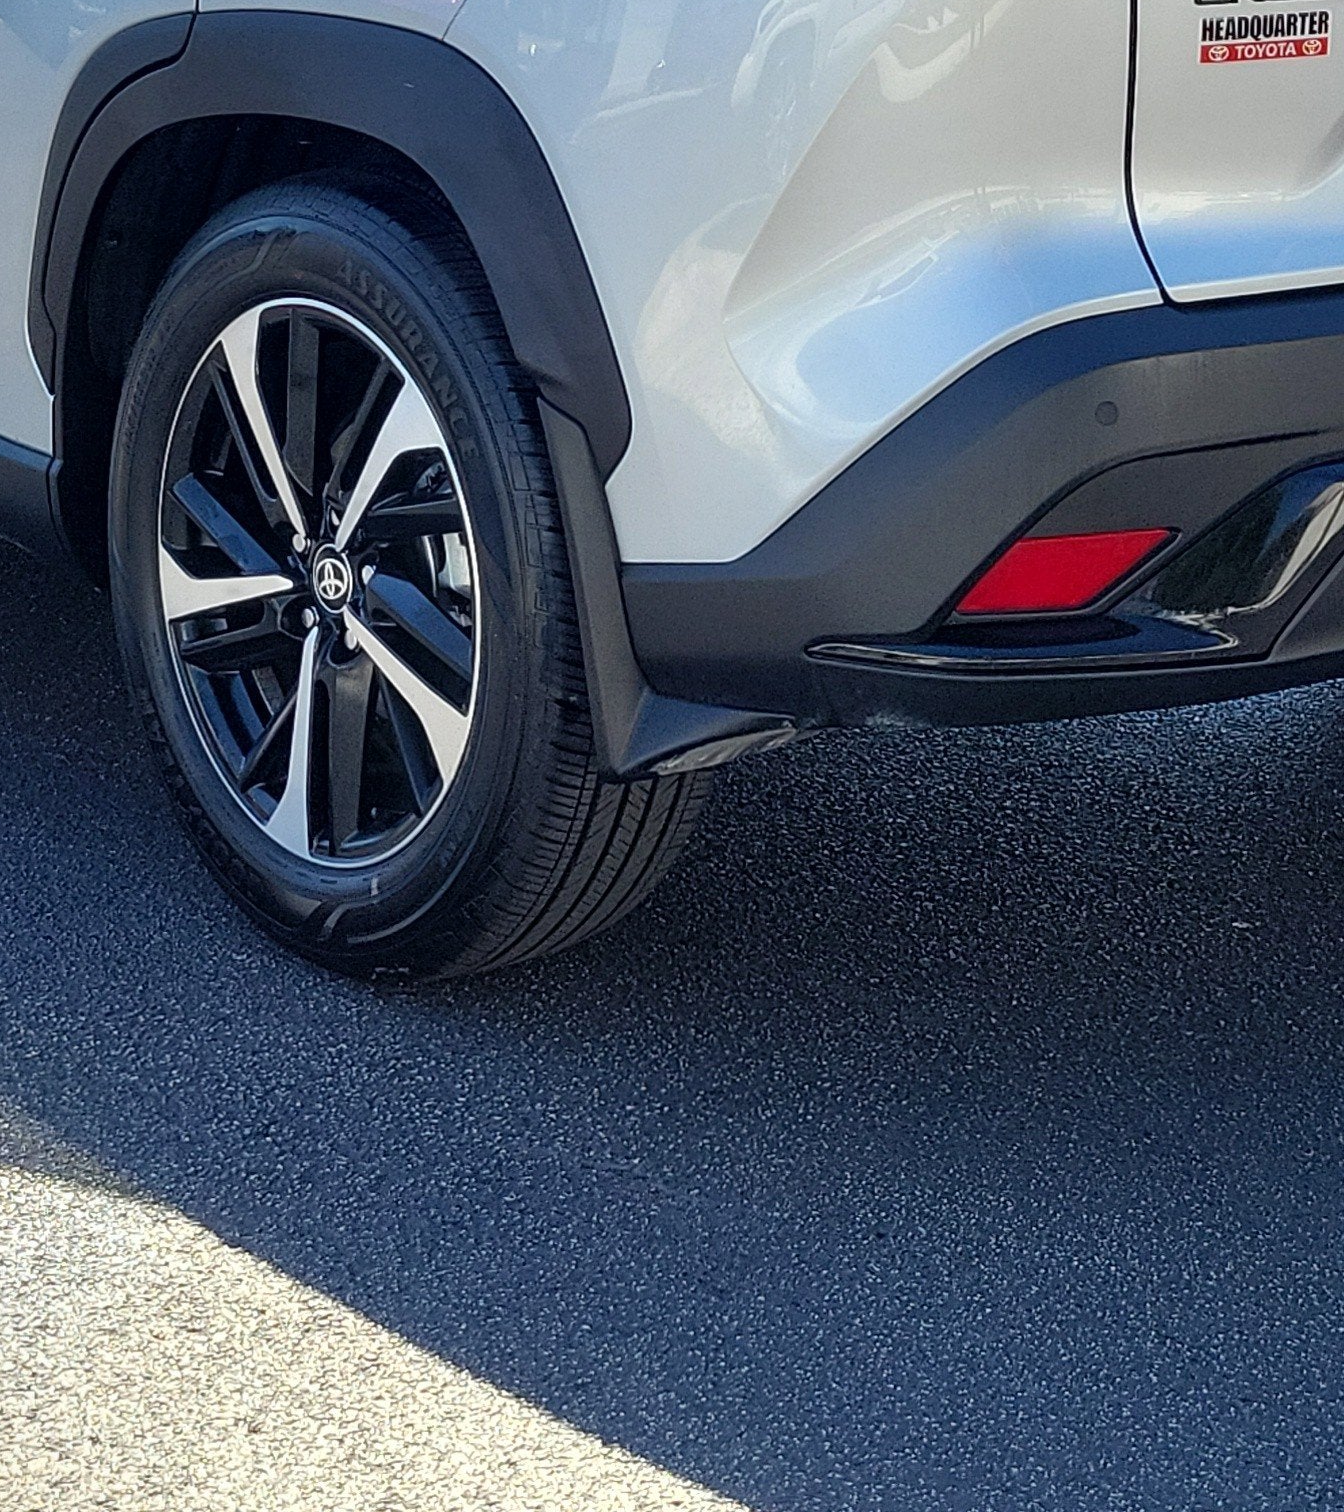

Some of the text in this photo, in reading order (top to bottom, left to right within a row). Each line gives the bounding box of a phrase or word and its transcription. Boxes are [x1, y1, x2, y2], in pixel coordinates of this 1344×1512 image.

[1201, 10, 1330, 42] HEADQUARTER
[1234, 41, 1297, 60] TOYOTA
[337, 260, 480, 459] ASSURANCE
